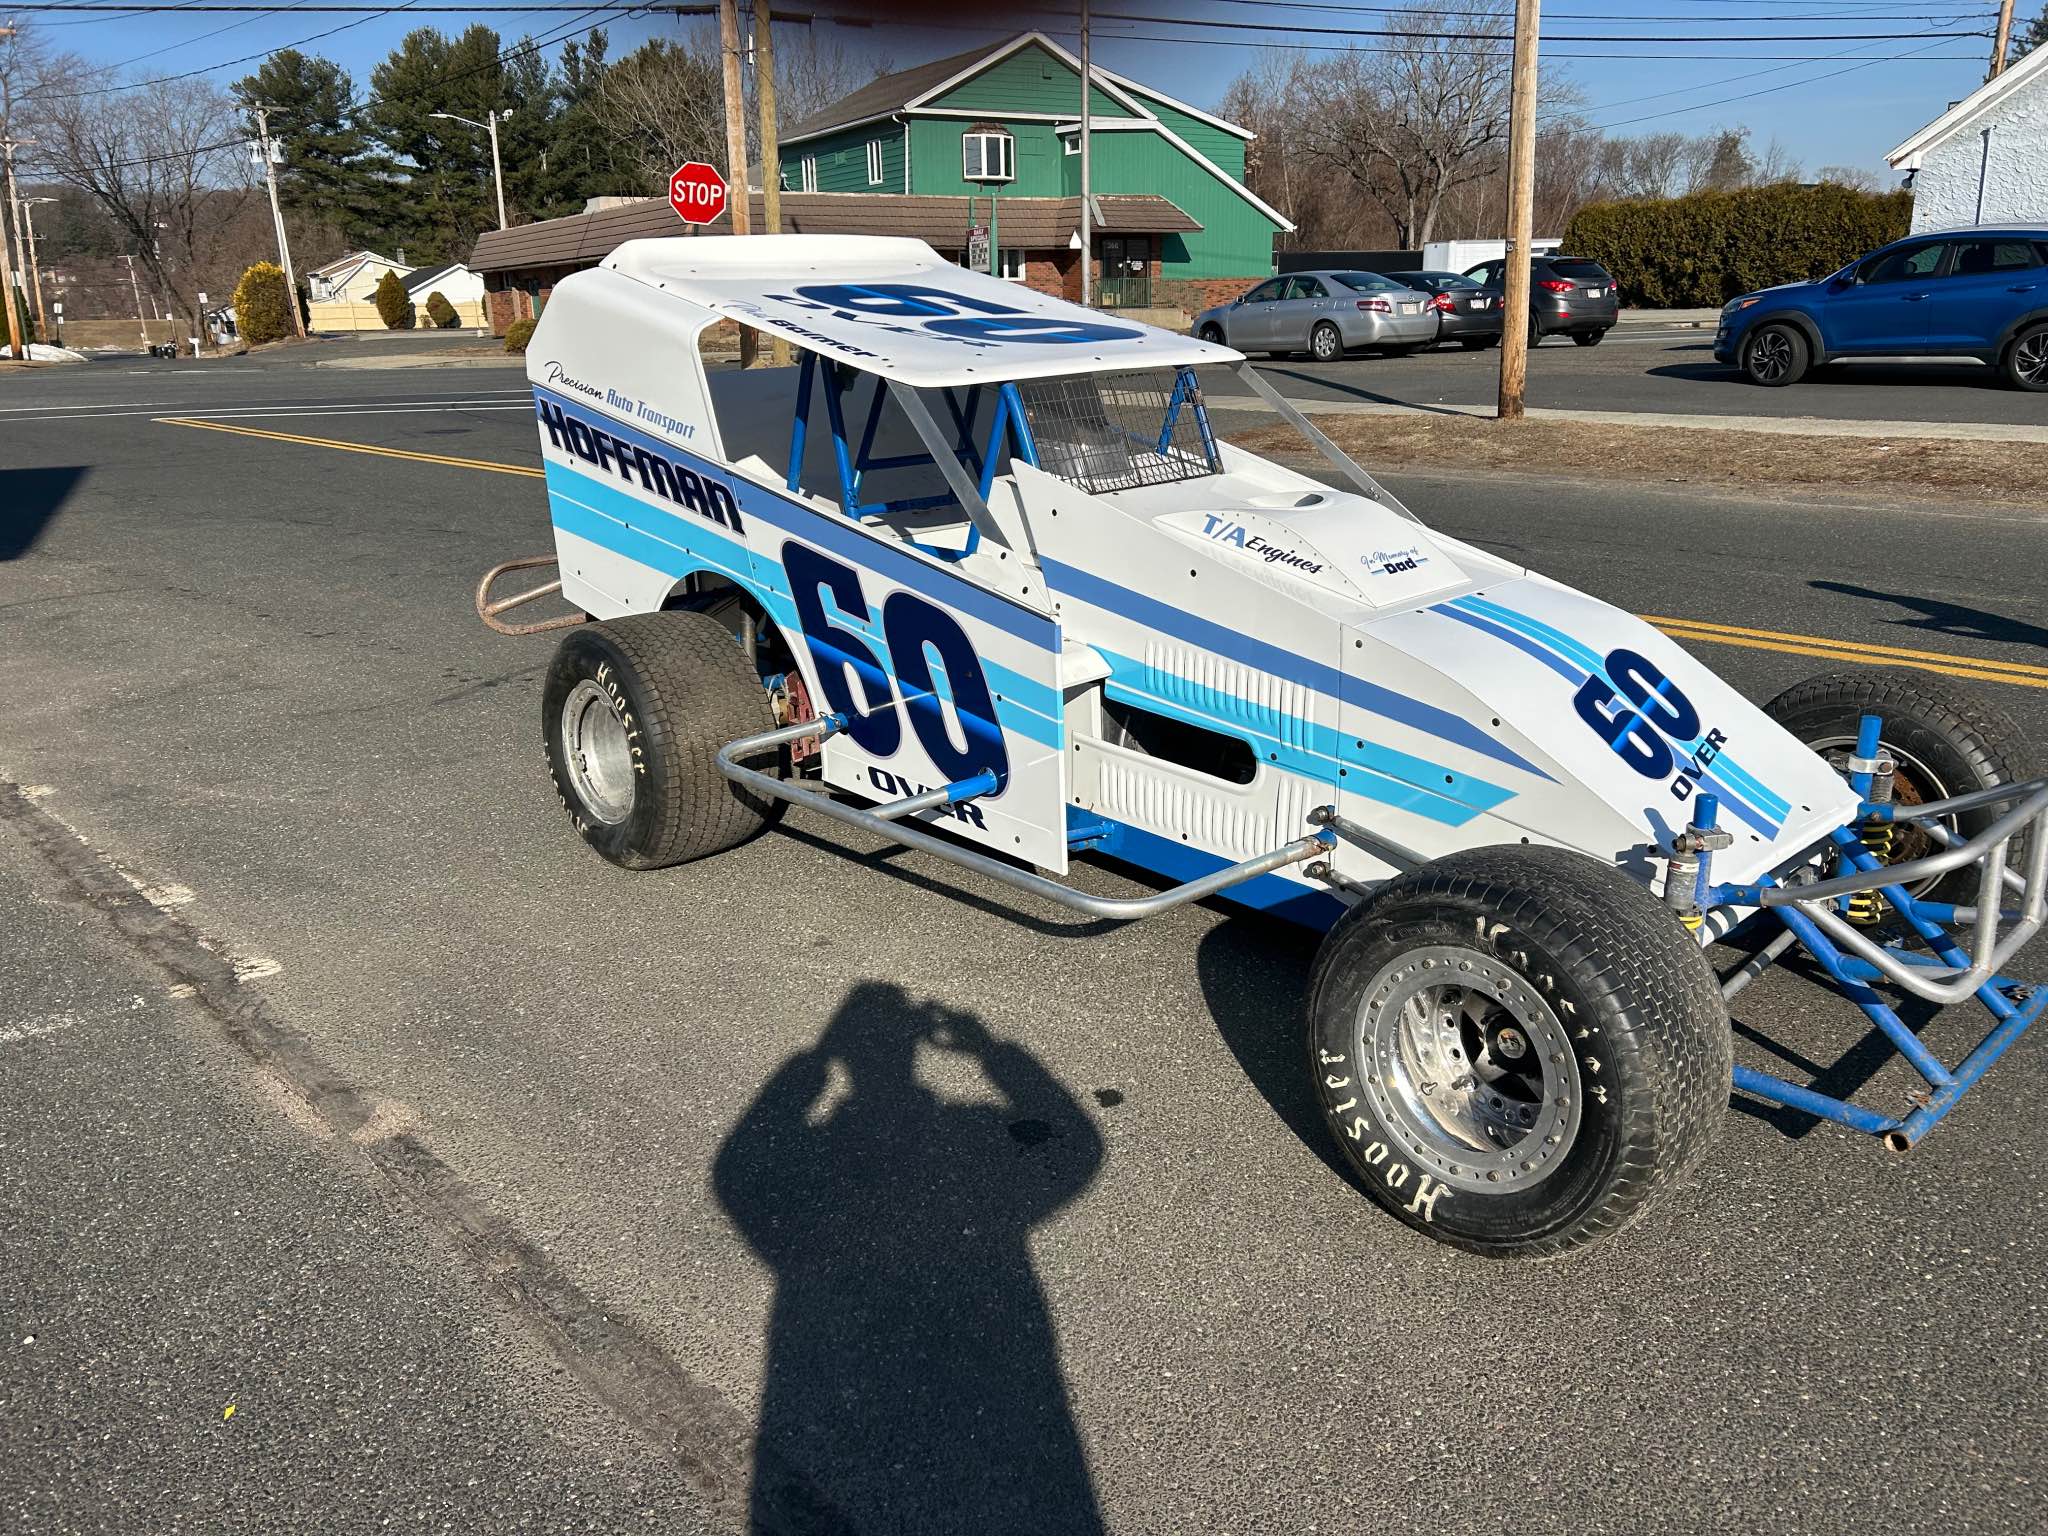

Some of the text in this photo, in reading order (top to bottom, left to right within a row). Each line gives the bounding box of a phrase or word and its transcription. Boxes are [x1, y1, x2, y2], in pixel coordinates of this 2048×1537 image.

[674, 180, 722, 206] STOP
[544, 360, 696, 440] Precision Auto Transport
[539, 398, 746, 536] HOFFMAN
[1202, 513, 1323, 574] T/A Engines
[1383, 557, 1418, 574] Dad
[780, 540, 1009, 799] 60
[1573, 648, 1700, 781] 60
[1670, 727, 1729, 802] OVER
